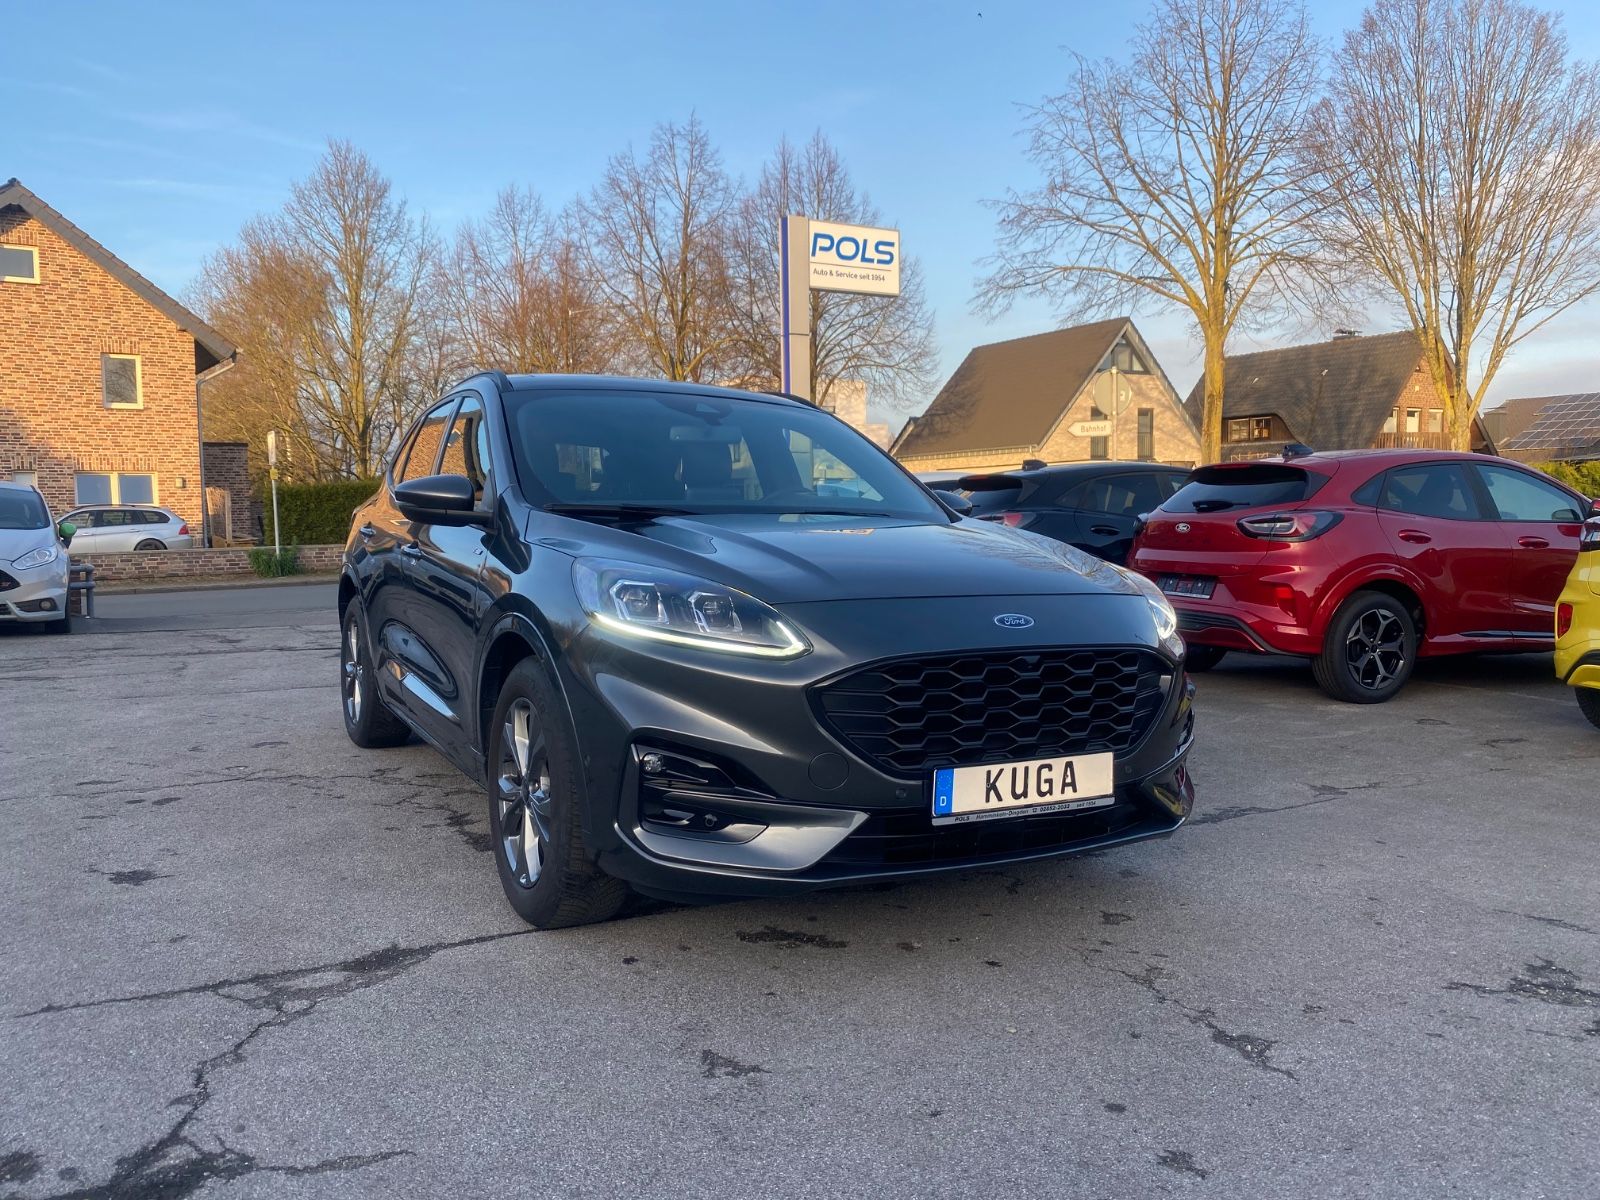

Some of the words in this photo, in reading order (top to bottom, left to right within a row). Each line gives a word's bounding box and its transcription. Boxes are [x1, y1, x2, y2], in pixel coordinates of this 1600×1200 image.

[811, 232, 895, 265] POLS
[813, 268, 828, 276] Auto
[835, 270, 858, 279] Service
[871, 274, 885, 282] 1954
[1004, 616, 1025, 625] Ford
[985, 760, 1077, 804] KUGA
[939, 796, 947, 807] D
